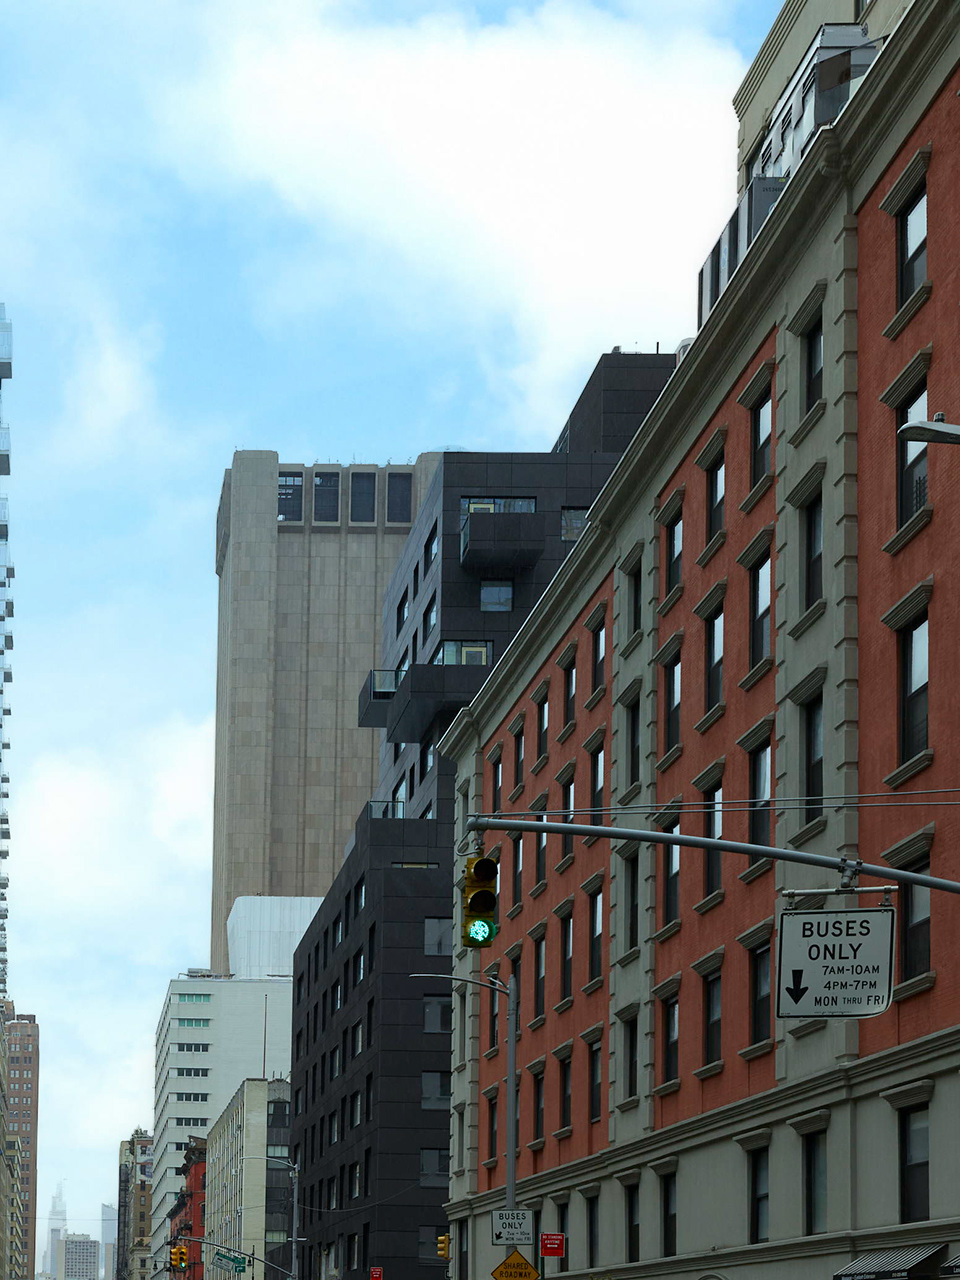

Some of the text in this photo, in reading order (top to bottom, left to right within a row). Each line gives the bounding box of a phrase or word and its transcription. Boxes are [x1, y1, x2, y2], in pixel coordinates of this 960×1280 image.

[802, 919, 871, 938] BUSES
[808, 943, 863, 961] ONLY
[822, 964, 880, 976] 7AM-10AM
[823, 980, 877, 991] 4PM-7PM
[814, 995, 885, 1006] MON THRU FRI
[501, 1222, 524, 1230] ONLY
[503, 1262, 529, 1270] SHARED
[500, 1271, 532, 1279] ROADWAY
